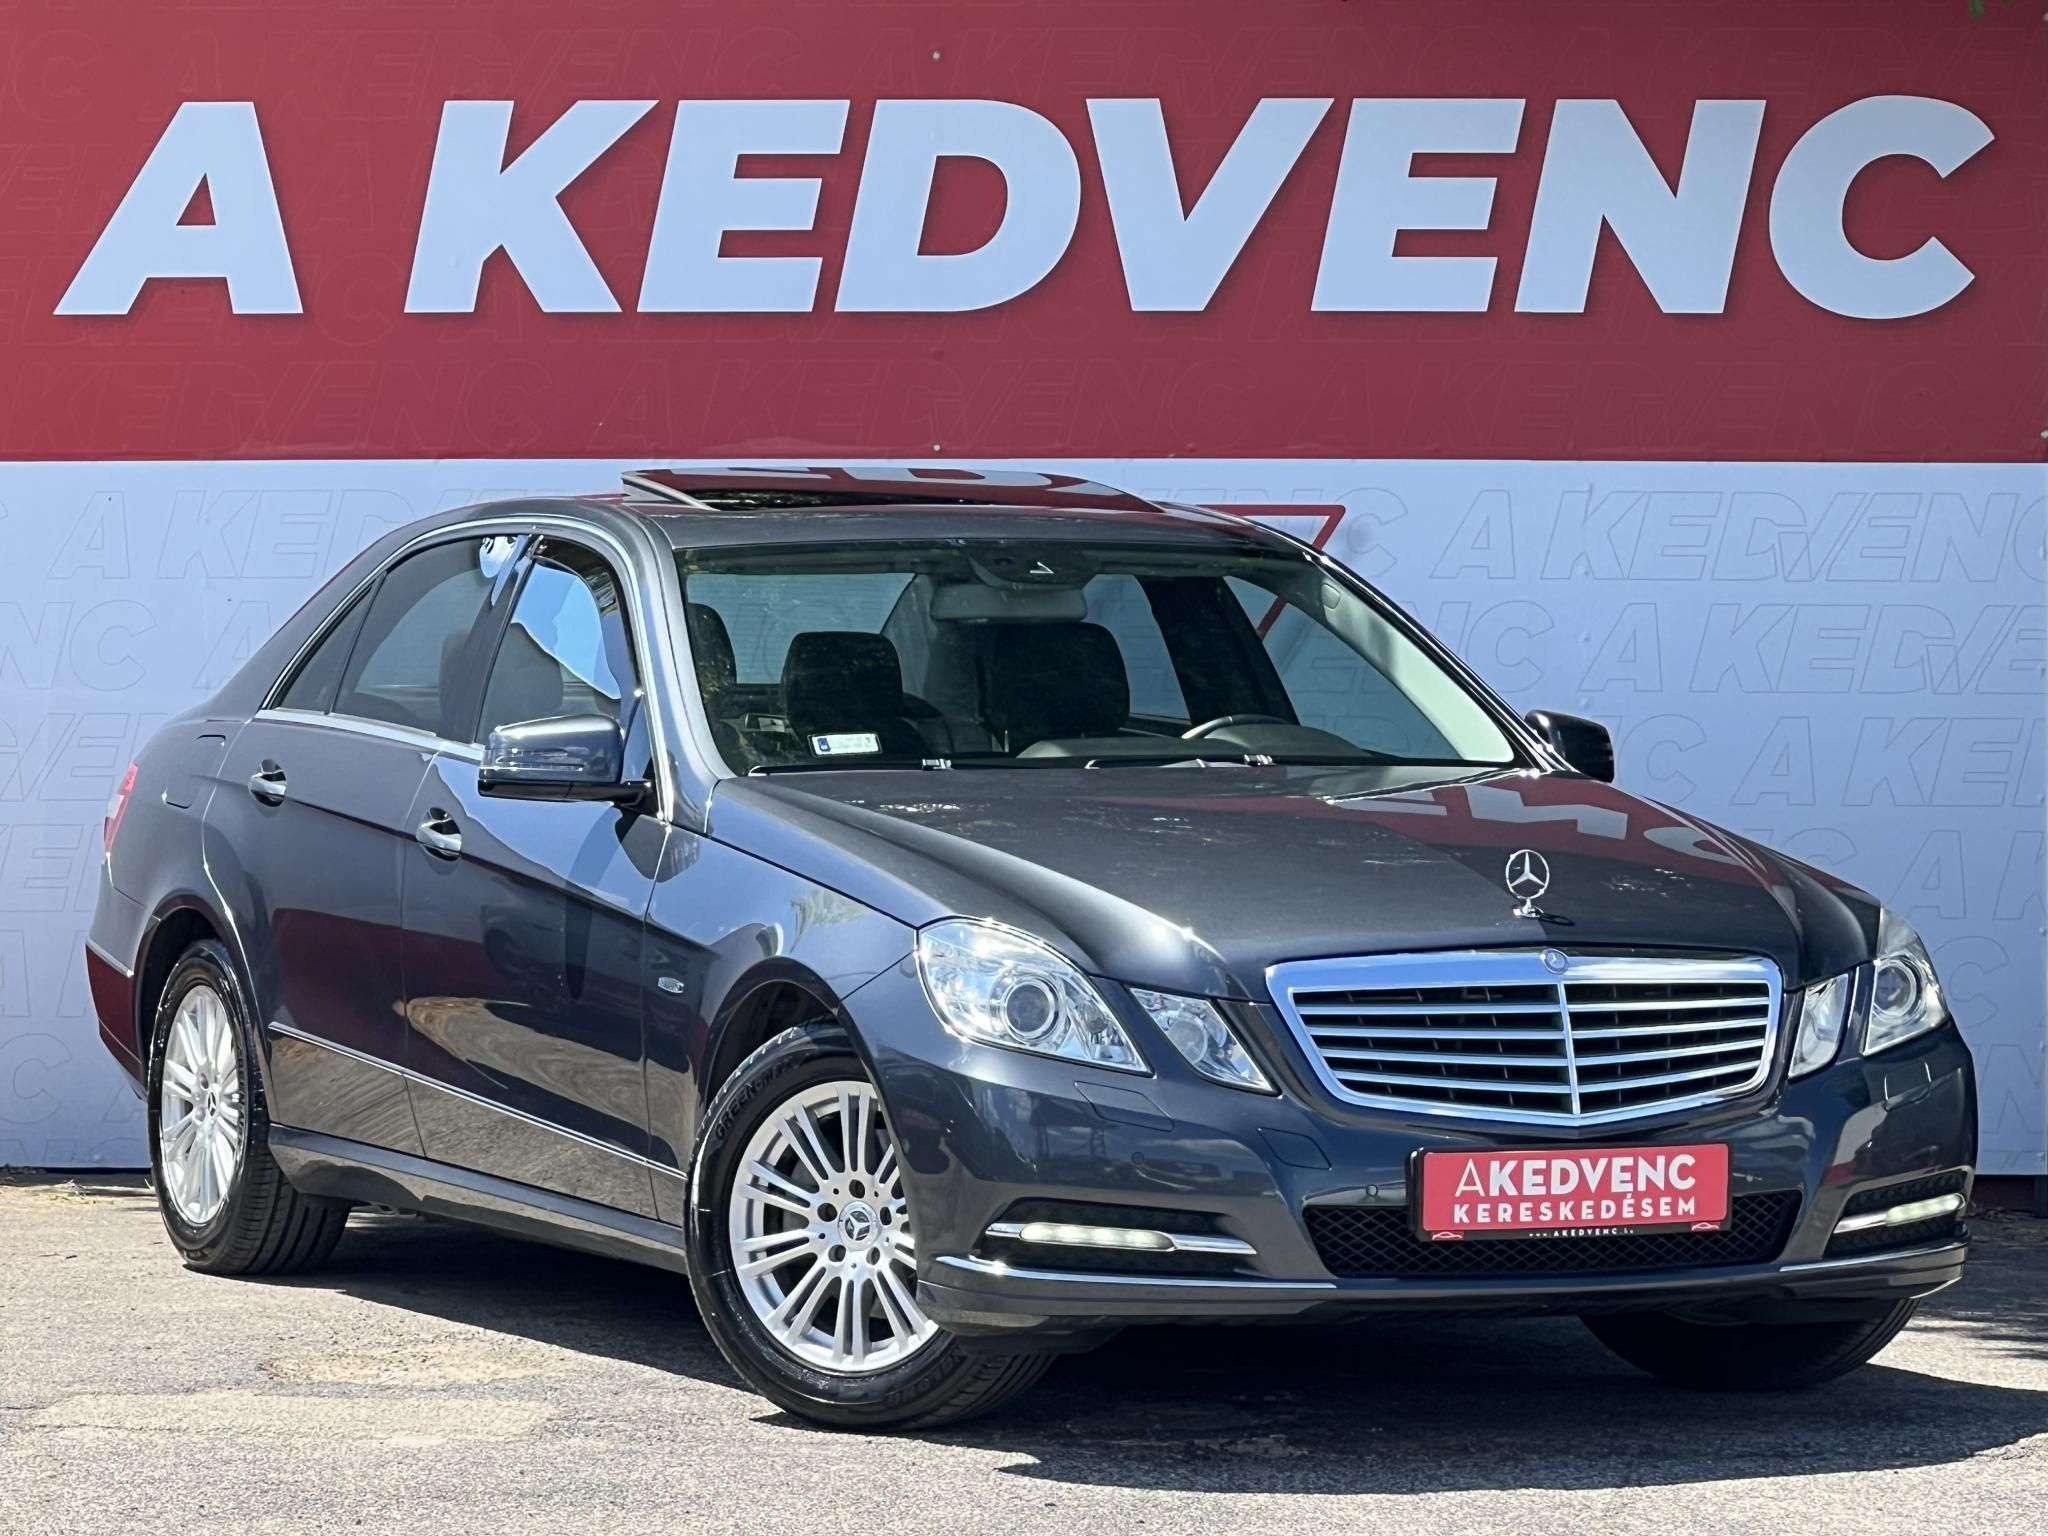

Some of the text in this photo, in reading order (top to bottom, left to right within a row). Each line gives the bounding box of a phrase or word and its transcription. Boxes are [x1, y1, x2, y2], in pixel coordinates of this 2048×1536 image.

[53, 101, 303, 315] A
[403, 95, 1996, 320] KEDVENC
[1429, 489, 1516, 580] A
[1577, 602, 1664, 692] A
[1729, 715, 1817, 807] A
[1454, 1194, 1696, 1224] KERESKEDÉSEM
